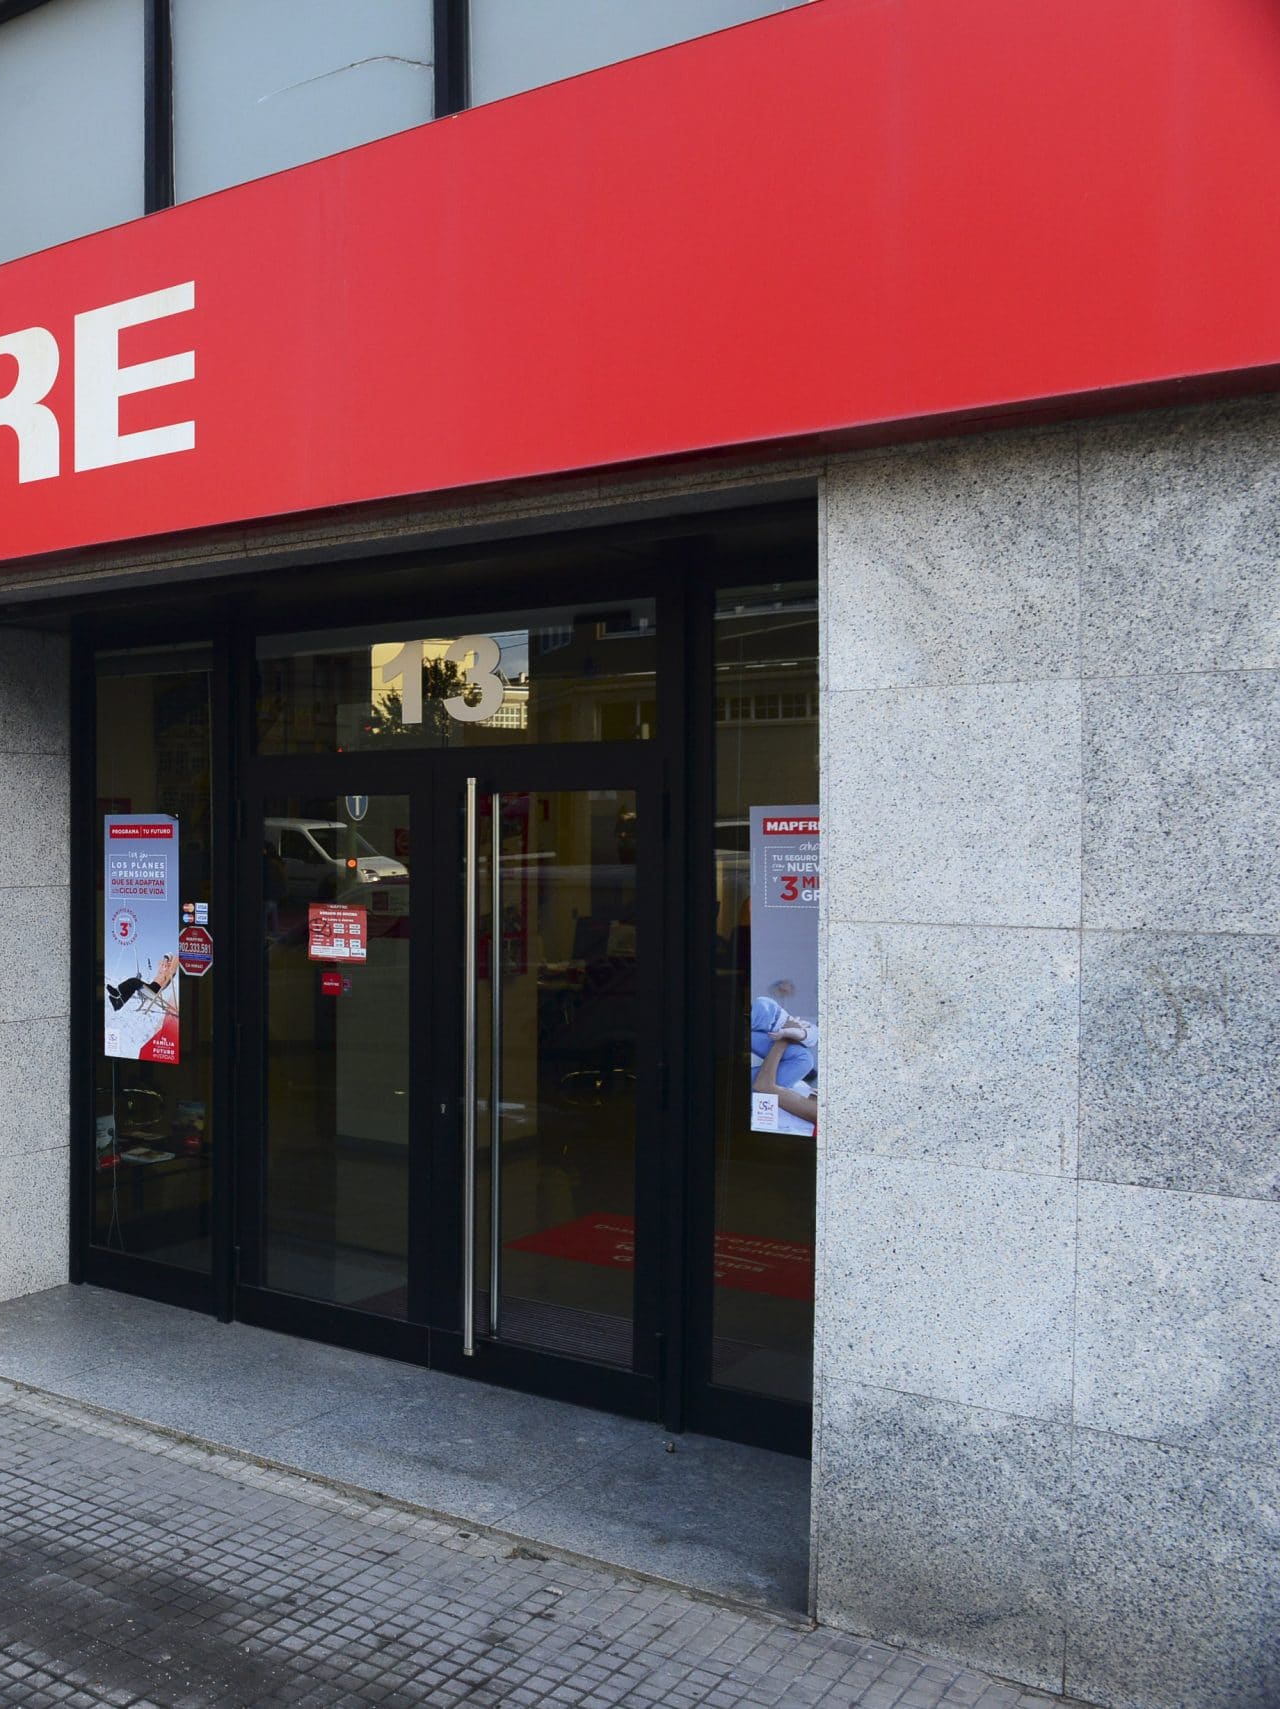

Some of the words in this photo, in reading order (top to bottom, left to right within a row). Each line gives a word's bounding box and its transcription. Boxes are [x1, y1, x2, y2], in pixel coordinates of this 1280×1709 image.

[382, 636, 503, 724] 13
[119, 870, 165, 878] PENSIONES
[781, 876, 799, 901] 3
